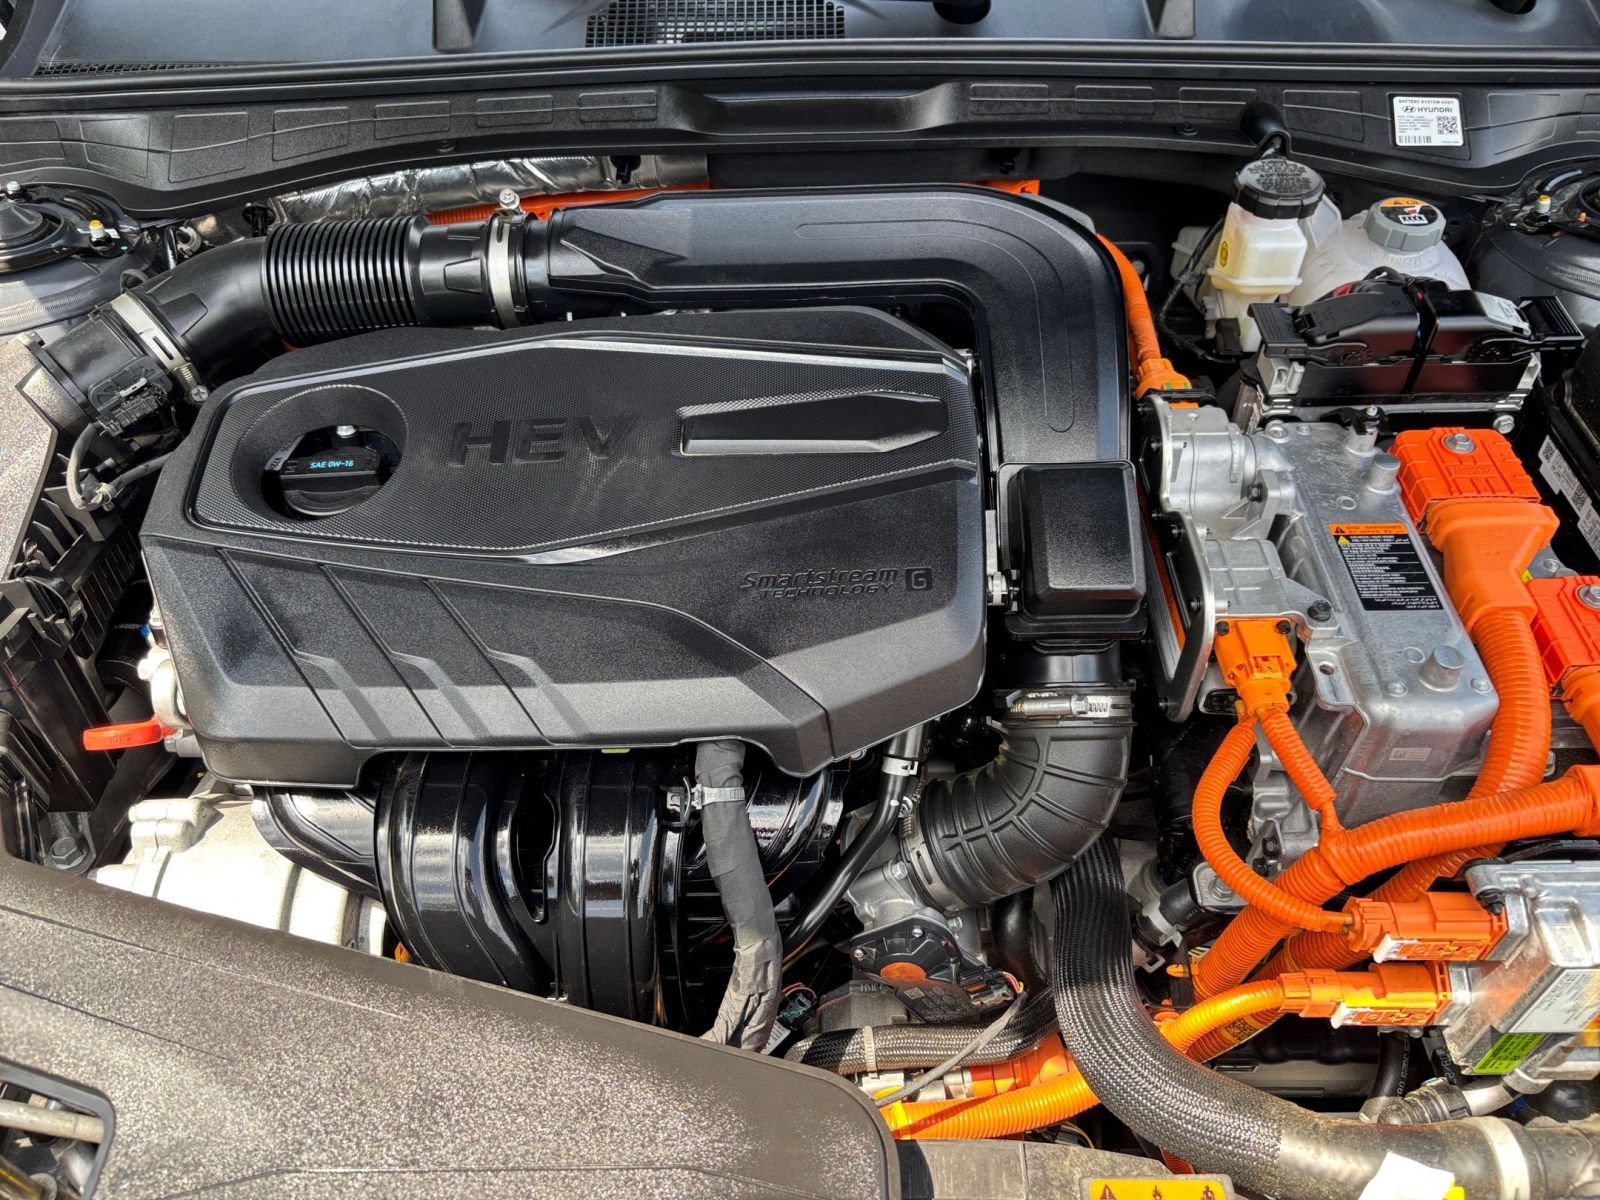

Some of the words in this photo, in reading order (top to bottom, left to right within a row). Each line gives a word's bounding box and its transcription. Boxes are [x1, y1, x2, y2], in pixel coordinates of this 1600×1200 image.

[449, 415, 636, 466] HEV
[310, 460, 327, 469] SAE
[740, 567, 899, 588] Smartstream
[758, 583, 894, 600] TECHNOLOGY
